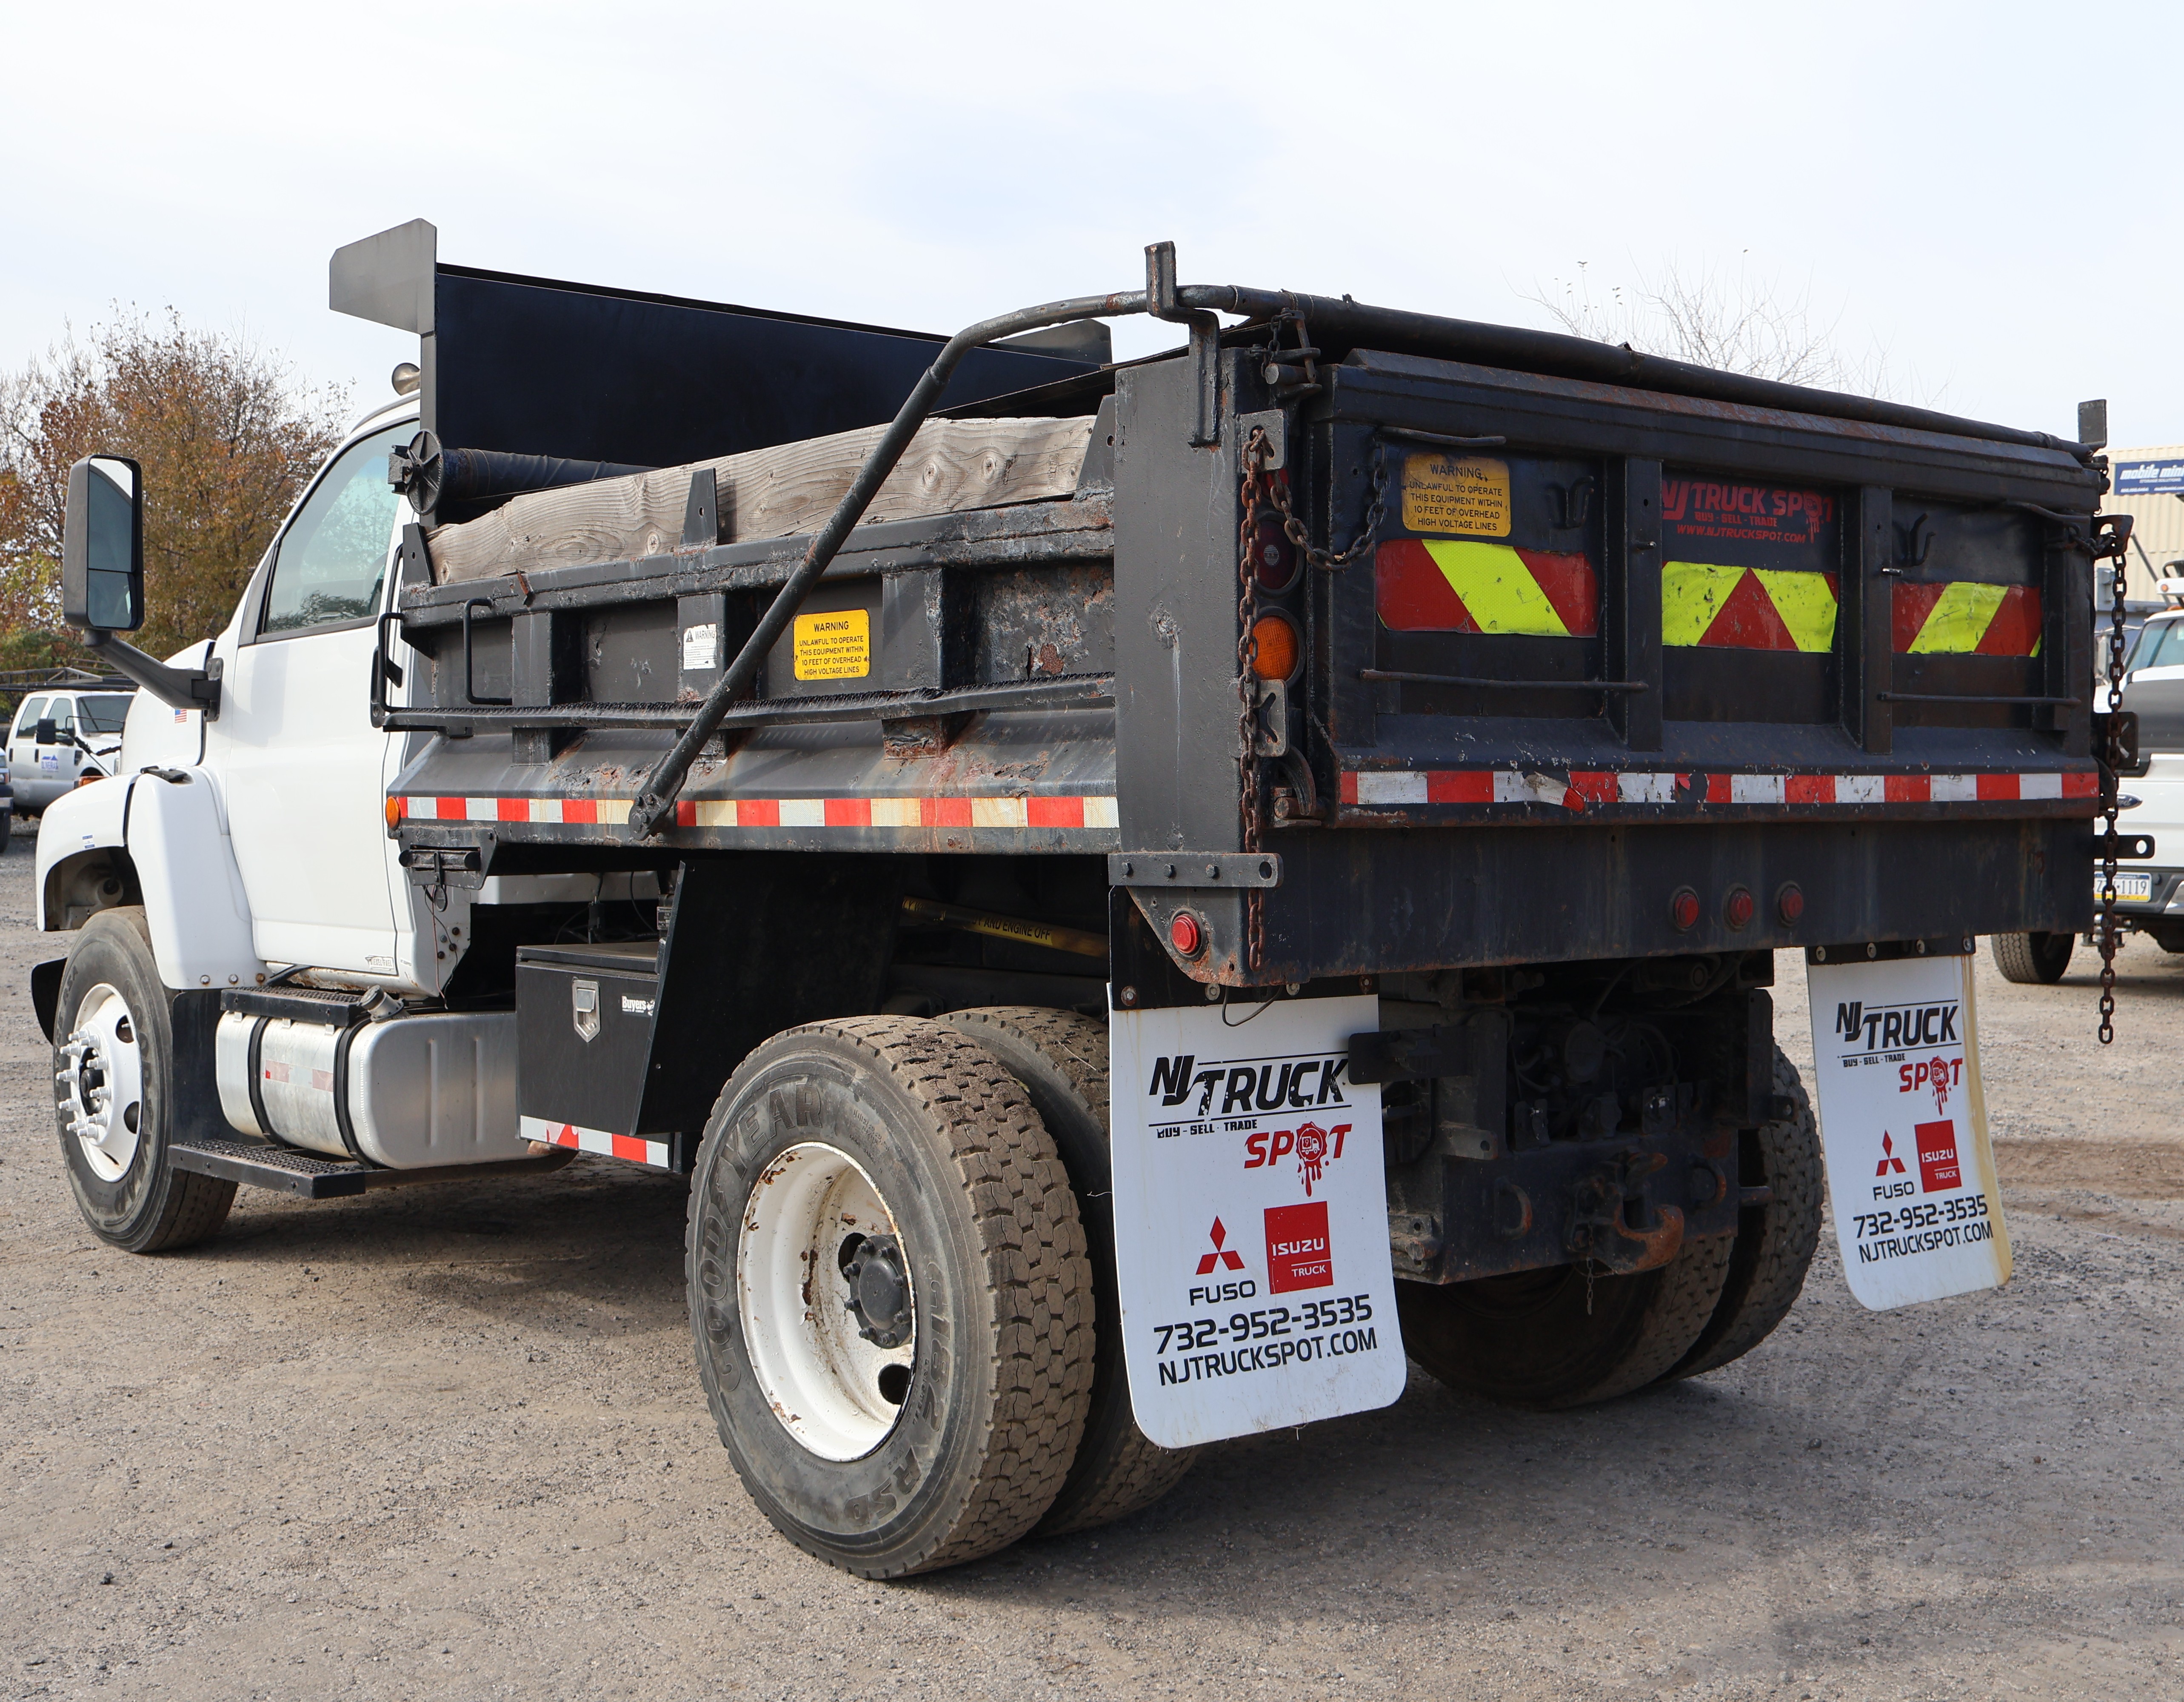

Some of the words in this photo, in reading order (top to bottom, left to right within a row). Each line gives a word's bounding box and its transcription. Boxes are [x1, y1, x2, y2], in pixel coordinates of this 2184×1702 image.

[1430, 463, 1481, 478] WARNING
[2119, 463, 2160, 480] mobile
[1409, 481, 1453, 492] UNLAWFUL
[1467, 486, 1502, 496] OPERATE
[1411, 493, 1428, 502] THIS
[1430, 494, 1475, 505] EQUIPMENT
[1477, 498, 1502, 508] WITHIN
[1414, 505, 1422, 514] 10
[1424, 506, 1444, 515] FEET
[1446, 507, 1456, 516] OF
[1458, 508, 1500, 519] OVERHEAD
[1417, 517, 1436, 526] HIGH
[1438, 518, 1473, 530] VOLTAGE
[1475, 521, 1497, 531] LINES
[1721, 514, 1742, 525] SELL
[1750, 515, 1777, 527] TRADE
[1677, 524, 1805, 544] WWW.NJTRUCKSPOT.COM
[814, 621, 849, 633] WARNING
[695, 630, 715, 640] WARNING
[799, 637, 829, 647] UNLAWFUL
[838, 636, 864, 644] OPERATE
[813, 647, 844, 656] EQUIPMENT
[832, 656, 862, 664] OVERHEAD
[818, 667, 842, 675] VOLTAGE
[843, 666, 859, 674] LINES
[983, 917, 1001, 930] AND
[1002, 922, 1032, 937] ENGINE
[1034, 925, 1053, 940] OFF
[622, 995, 646, 1012] Buyers
[1843, 1057, 1858, 1068] BUY
[1864, 1056, 1879, 1065] SELL
[1885, 1053, 1906, 1062] TRADE
[1190, 1124, 1213, 1135] SELL
[1224, 1119, 1257, 1131] TRADE
[1921, 1148, 1954, 1162] ISUZU
[1935, 1170, 1957, 1180] TRUCK
[1873, 1181, 1915, 1201] FUSO
[1853, 1194, 1988, 1239] 732-952-3535
[1272, 1237, 1325, 1257] ISUZU
[1859, 1220, 1993, 1263] NJTRUCKSPOT.COM
[1291, 1263, 1327, 1278] TRUCK
[1189, 1279, 1256, 1306] FUSO
[1153, 1294, 1373, 1354] 732-952-3535
[1159, 1327, 1378, 1385] NJTRUCKSPOT.COM
